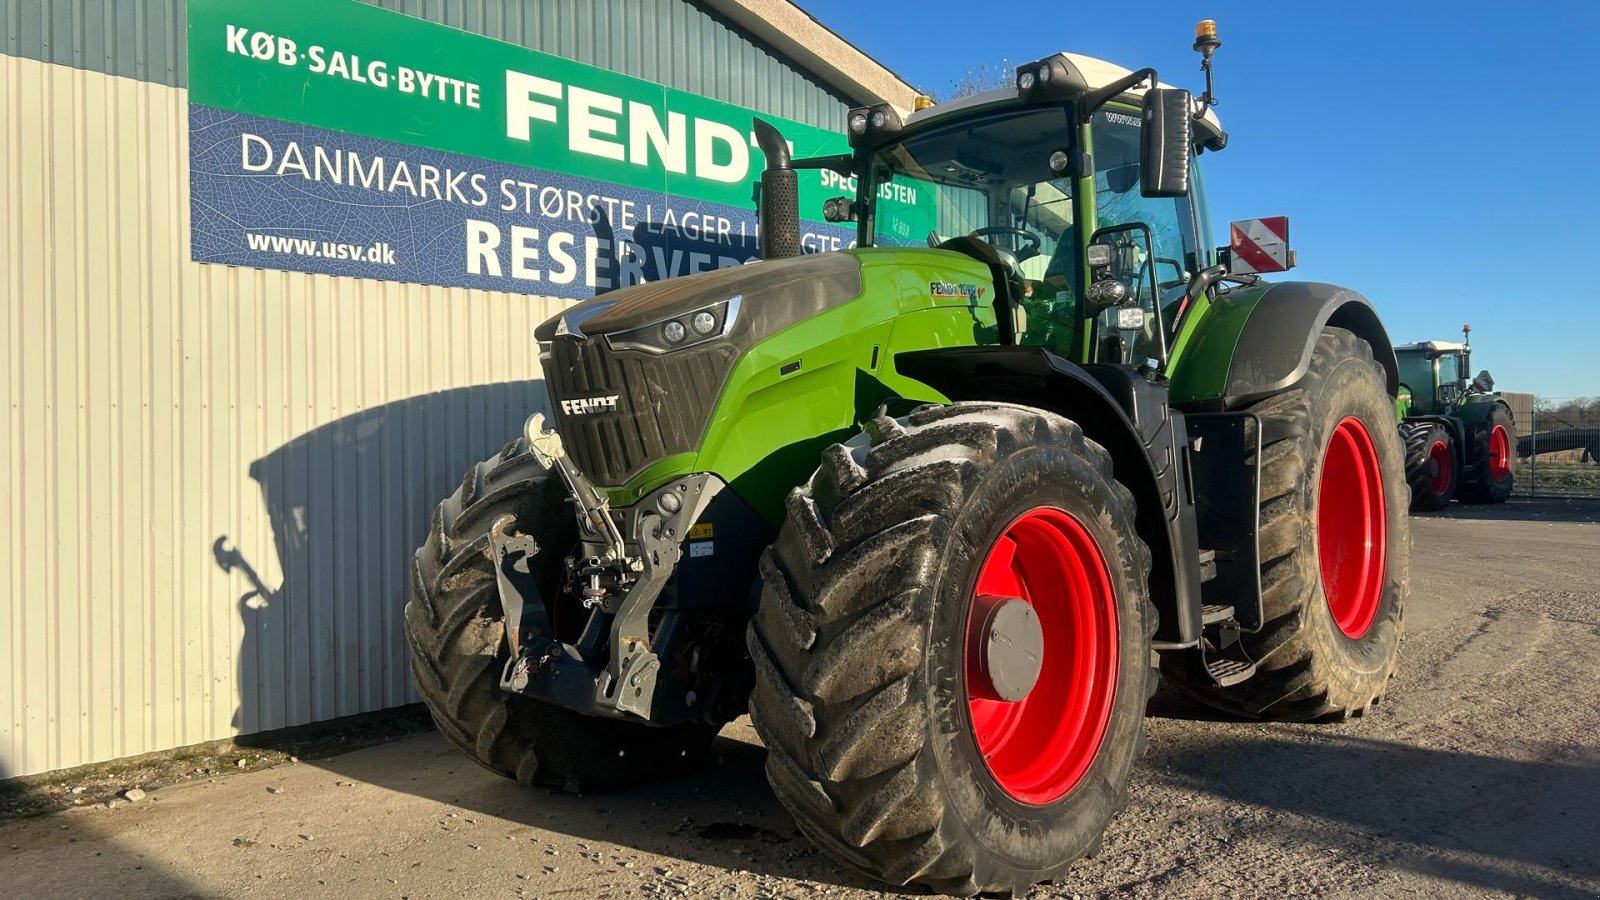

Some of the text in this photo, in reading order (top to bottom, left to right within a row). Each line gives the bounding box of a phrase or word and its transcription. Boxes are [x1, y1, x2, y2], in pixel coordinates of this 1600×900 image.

[241, 133, 489, 207] DANMARKS
[500, 178, 635, 231] STØRSTE
[646, 204, 732, 246] LAGER
[247, 233, 396, 266] www.usv.dk
[561, 394, 620, 416] FENDT
